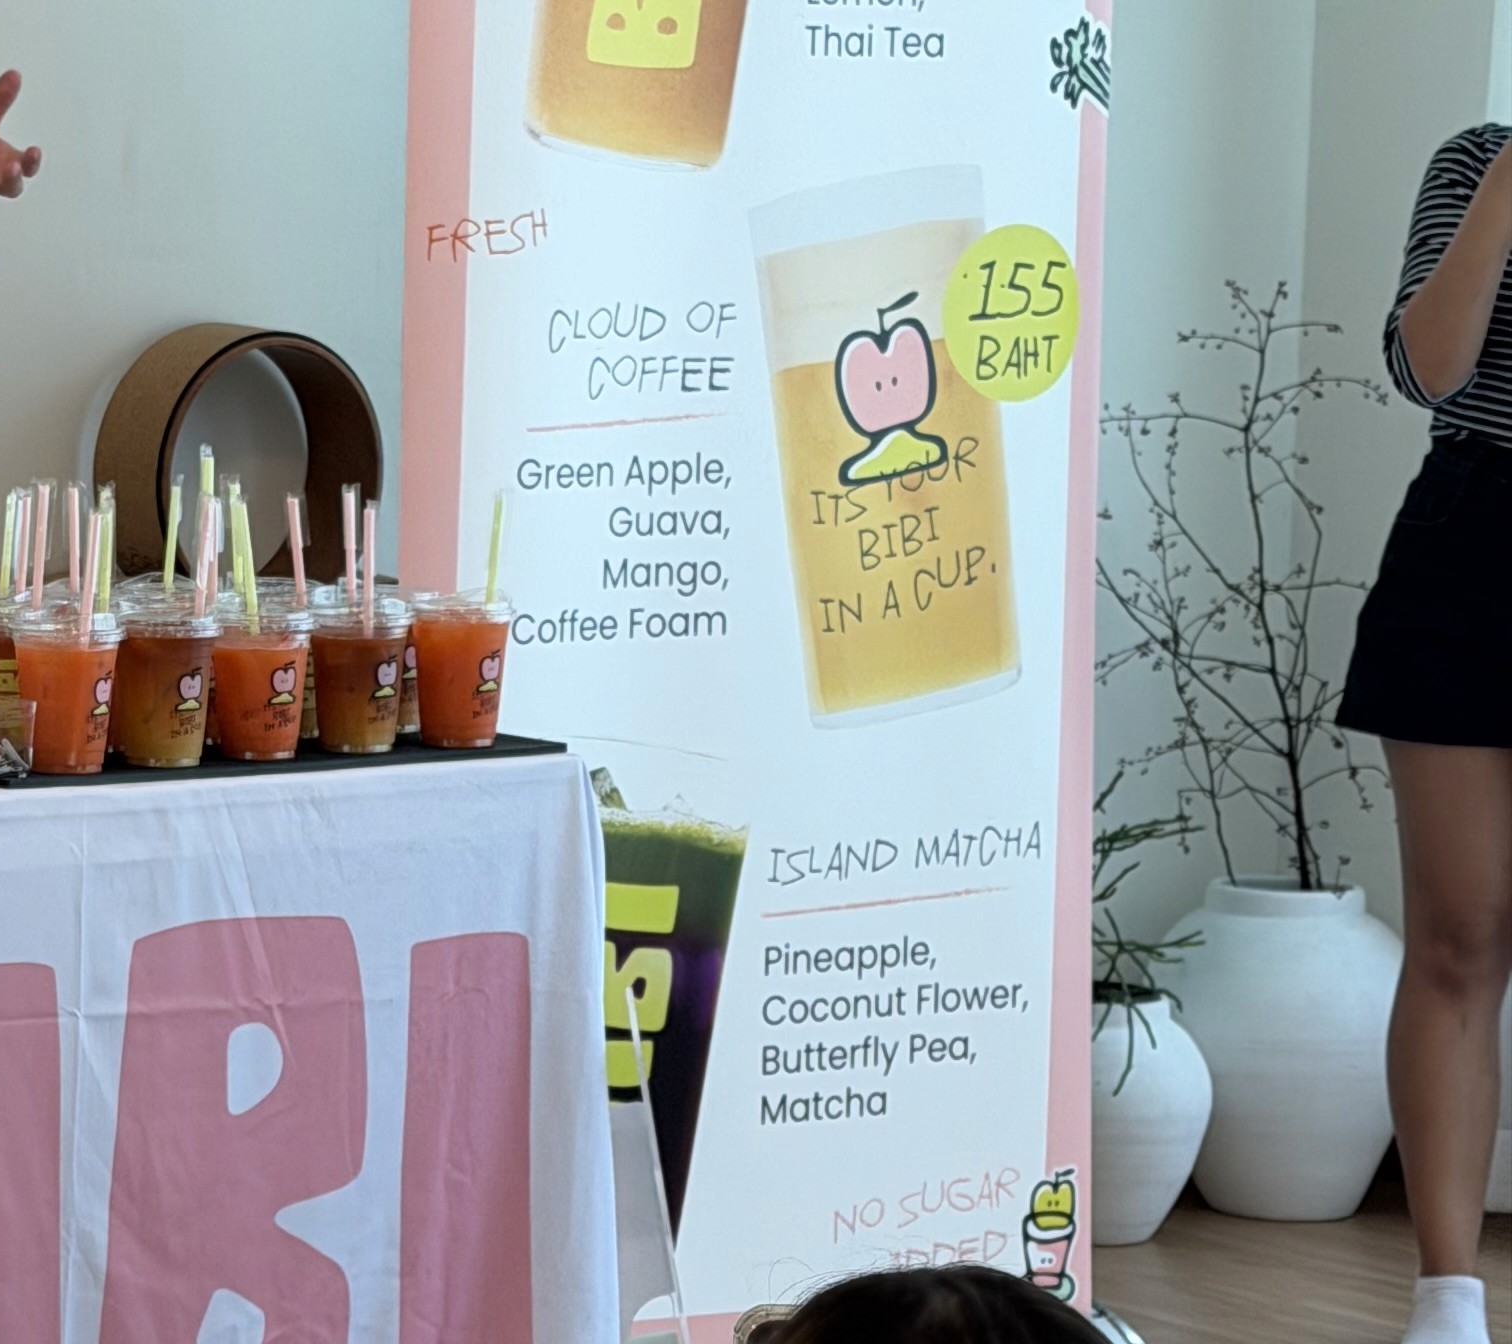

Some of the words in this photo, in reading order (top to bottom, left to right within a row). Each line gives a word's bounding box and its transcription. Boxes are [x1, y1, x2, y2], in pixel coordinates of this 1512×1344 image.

[806, 25, 874, 58] Thai
[884, 25, 944, 59] Tea
[427, 209, 549, 260] FRESH
[968, 261, 1066, 322] 155
[549, 303, 667, 354] CLOUD
[687, 302, 737, 339] OF
[588, 356, 735, 401] COFFEE
[976, 335, 1061, 381] BAHT
[516, 456, 614, 489] Green
[624, 452, 733, 490] Apple,
[810, 484, 868, 526] ITS
[879, 437, 979, 502] YOUR
[609, 506, 730, 540] Guava,
[858, 507, 940, 571] BIBI
[602, 558, 729, 597] Mango,
[819, 593, 862, 634] IN
[882, 580, 901, 619] A
[914, 546, 996, 611] CUP.
[511, 611, 617, 647] Coffee
[629, 607, 727, 642] Foam
[767, 837, 898, 885] ISLAND
[914, 821, 1042, 871] MATCHA
[763, 936, 937, 979] Pineapple,
[761, 985, 907, 1026] Coconut
[916, 979, 1029, 1017] Flower,
[760, 1037, 898, 1077] Butterfly
[909, 1032, 976, 1068] Pea,
[760, 1087, 888, 1125] Matcha
[833, 1198, 885, 1244] NO
[897, 1167, 1021, 1229] SUGAR
